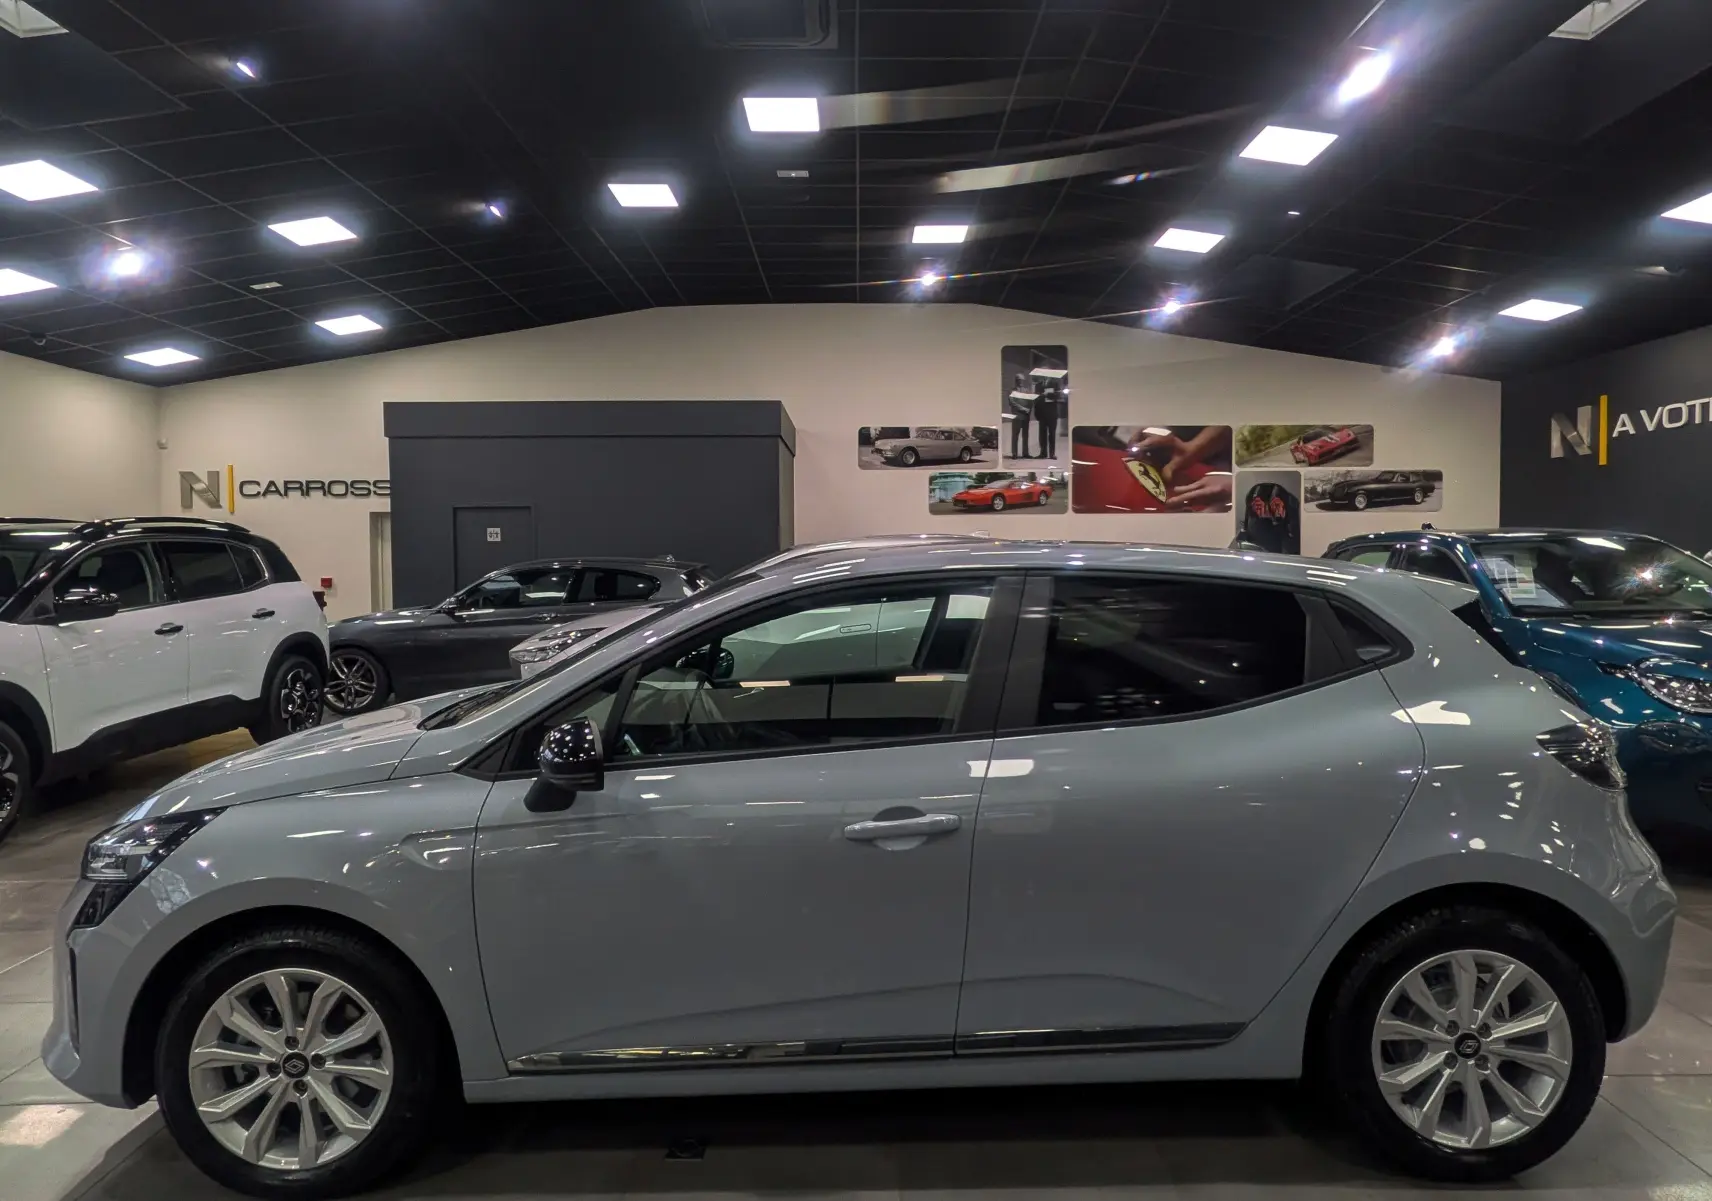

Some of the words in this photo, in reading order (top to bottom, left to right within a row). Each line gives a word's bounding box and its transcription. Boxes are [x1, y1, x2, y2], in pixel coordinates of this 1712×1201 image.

[1612, 413, 1636, 438] A
[1640, 397, 1712, 431] VOT
[239, 479, 391, 498] CARROSS
